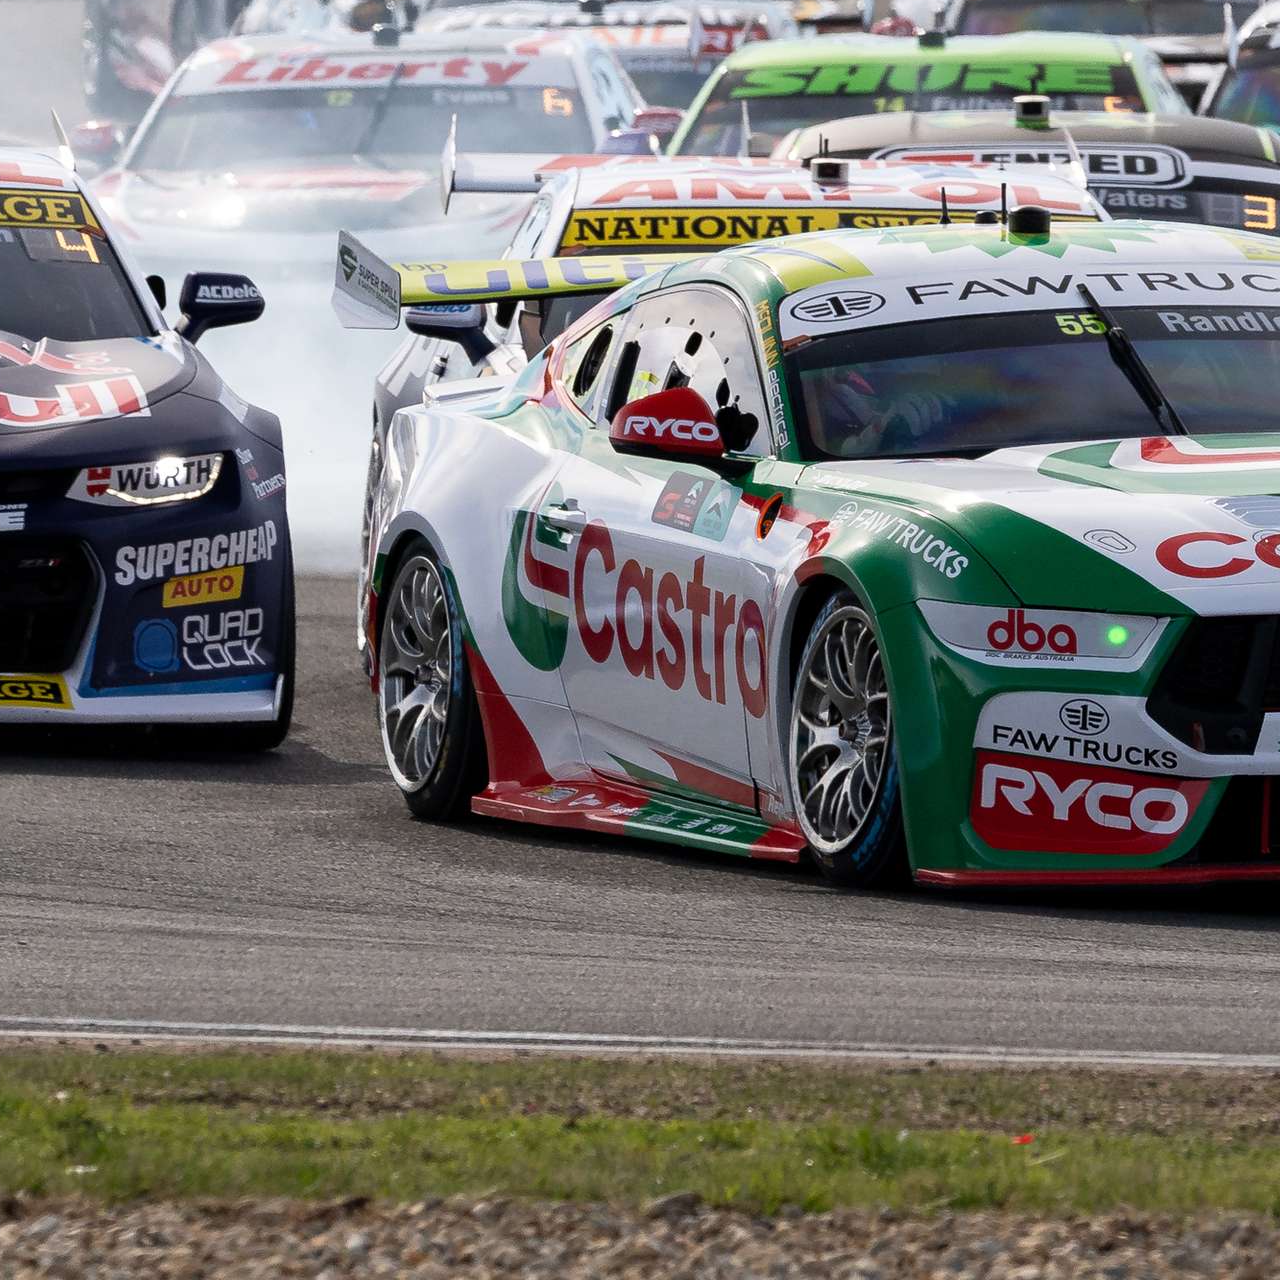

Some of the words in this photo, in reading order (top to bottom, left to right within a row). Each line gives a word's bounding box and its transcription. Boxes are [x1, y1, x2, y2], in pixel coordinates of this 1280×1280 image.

[217, 55, 529, 86] Liberty
[729, 61, 1114, 99] SHURE
[574, 216, 824, 242] NATIONAL
[1244, 194, 1277, 229] 3
[55, 229, 100, 263] 4
[197, 283, 262, 299] ACDelc
[358, 263, 380, 289] SUPER
[381, 281, 398, 304] SPILL
[906, 275, 1078, 306] FAW
[1055, 312, 1107, 335] 55
[768, 370, 791, 450] electrical
[623, 416, 720, 442] RYCO
[115, 520, 278, 586] SUPERCHEAP
[848, 508, 897, 535] FAW
[887, 518, 969, 578] TRUCKS
[171, 575, 234, 599] AUTO
[182, 607, 264, 644] QUAD
[574, 518, 767, 719] Castro
[987, 609, 1077, 654] dba
[182, 637, 267, 670] LOCK
[992, 725, 1062, 754] FAW
[1066, 737, 1178, 770] TRUCKS
[979, 763, 1189, 835] RYCO
